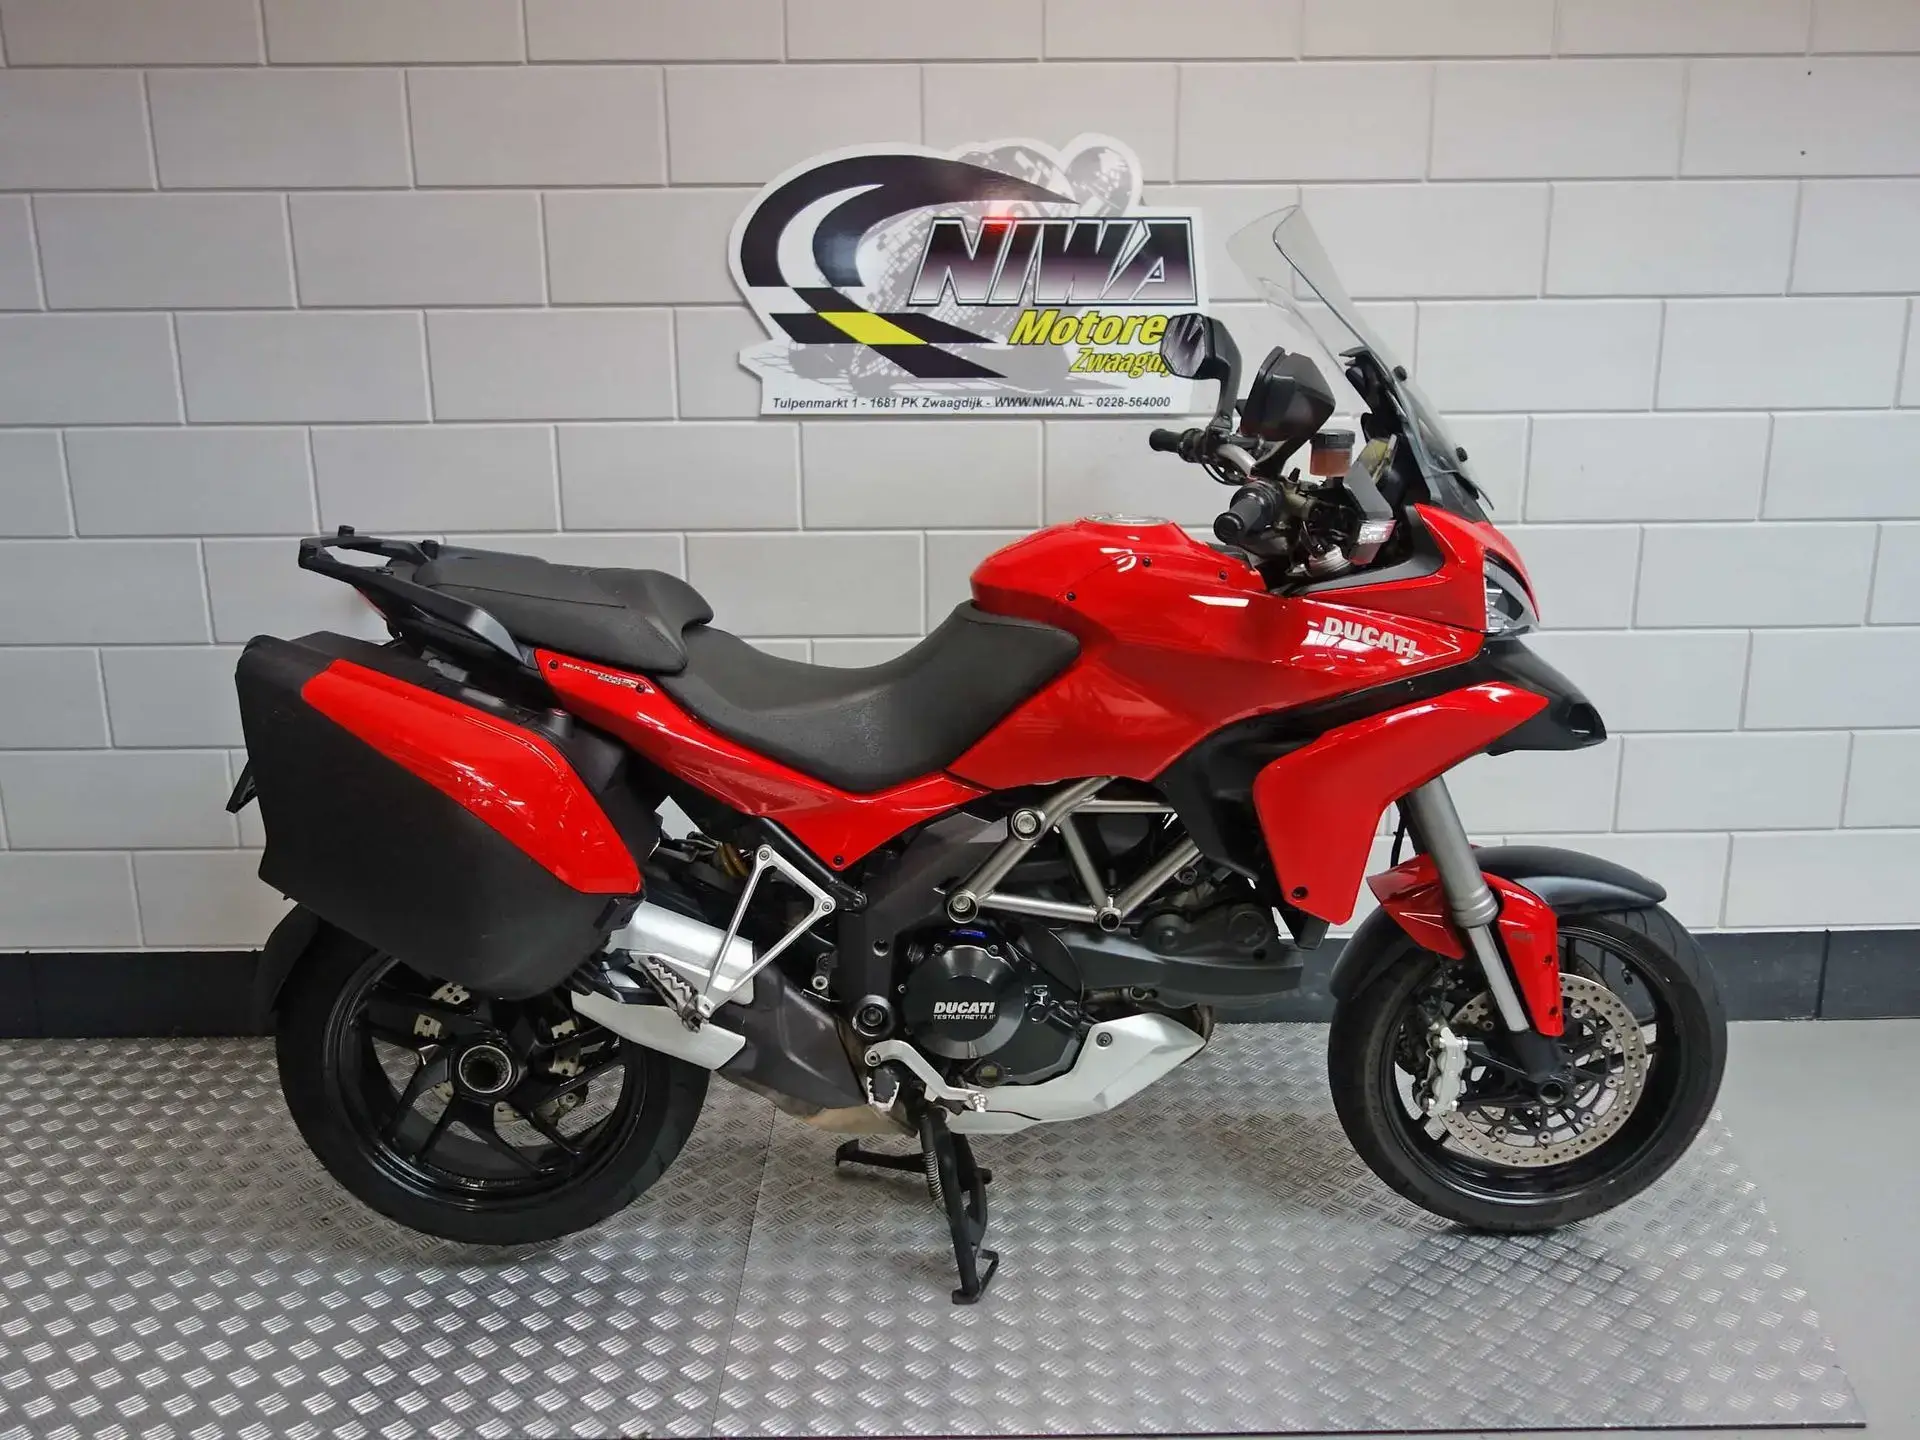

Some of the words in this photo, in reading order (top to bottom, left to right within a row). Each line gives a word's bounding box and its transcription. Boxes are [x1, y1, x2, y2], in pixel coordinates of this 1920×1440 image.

[907, 217, 1197, 306] NIWA
[1007, 309, 1169, 346] Motore
[773, 397, 848, 411] Tulpenmarkt
[852, 398, 858, 408] 1
[870, 397, 897, 408] 1681
[901, 398, 918, 408] PK
[922, 397, 983, 411] Zwaagdijk
[995, 397, 1085, 408] WWW.NIWA.NL
[1096, 396, 1171, 408] 0228-564000
[1322, 616, 1418, 659] DUCATI
[933, 1001, 996, 1014] DUCATI
